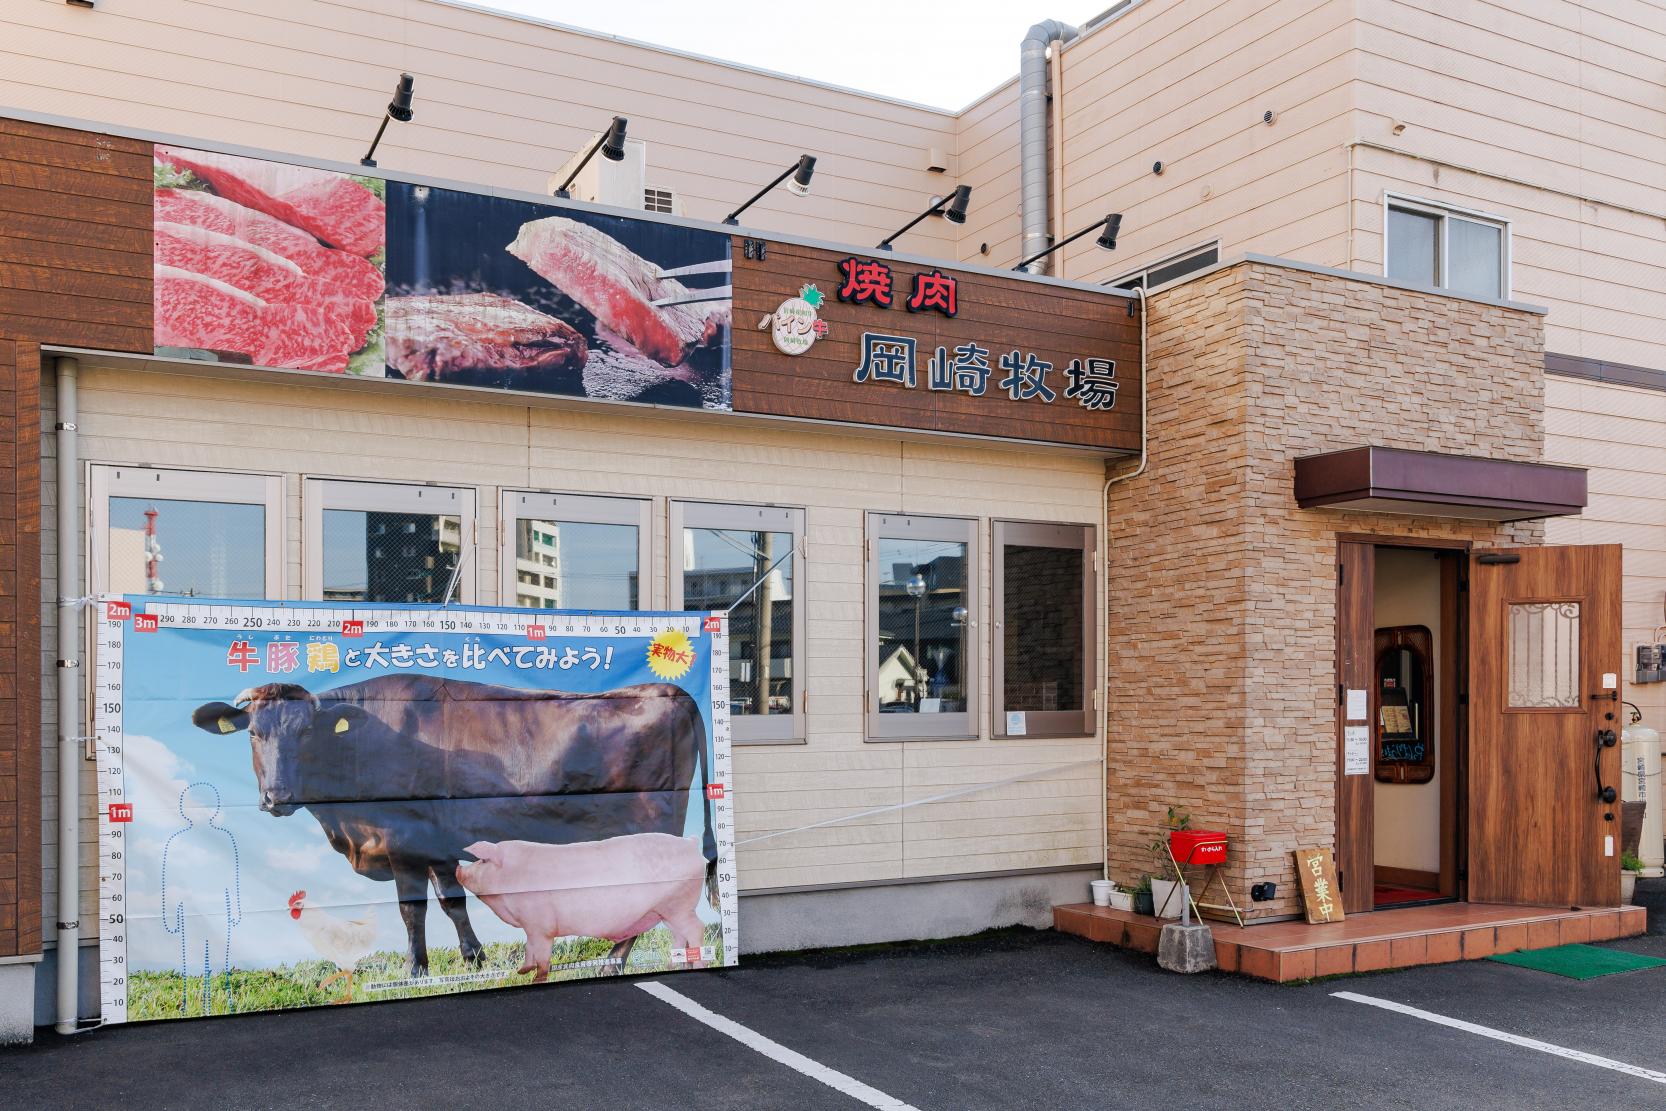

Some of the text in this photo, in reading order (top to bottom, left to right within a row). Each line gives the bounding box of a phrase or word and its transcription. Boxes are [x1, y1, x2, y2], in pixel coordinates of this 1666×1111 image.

[838, 257, 957, 317] 焼肉
[757, 313, 829, 341] パイン牛
[853, 332, 1120, 410] 岡崎牧場
[109, 604, 129, 616] 2m
[108, 620, 121, 628] 190
[136, 617, 156, 628] 3m
[160, 615, 175, 623] 290
[225, 617, 239, 625] 260
[243, 618, 262, 627] 250
[267, 618, 280, 626] 240
[343, 624, 362, 634] 2m
[440, 621, 456, 630] 150
[460, 621, 472, 629] 140
[528, 628, 544, 638] 1m
[615, 626, 625, 634] 50
[704, 619, 720, 629] 2m
[103, 703, 120, 713] 150
[111, 807, 131, 818] 1m
[1307, 853, 1334, 921] 営業中
[109, 914, 123, 923] 50
